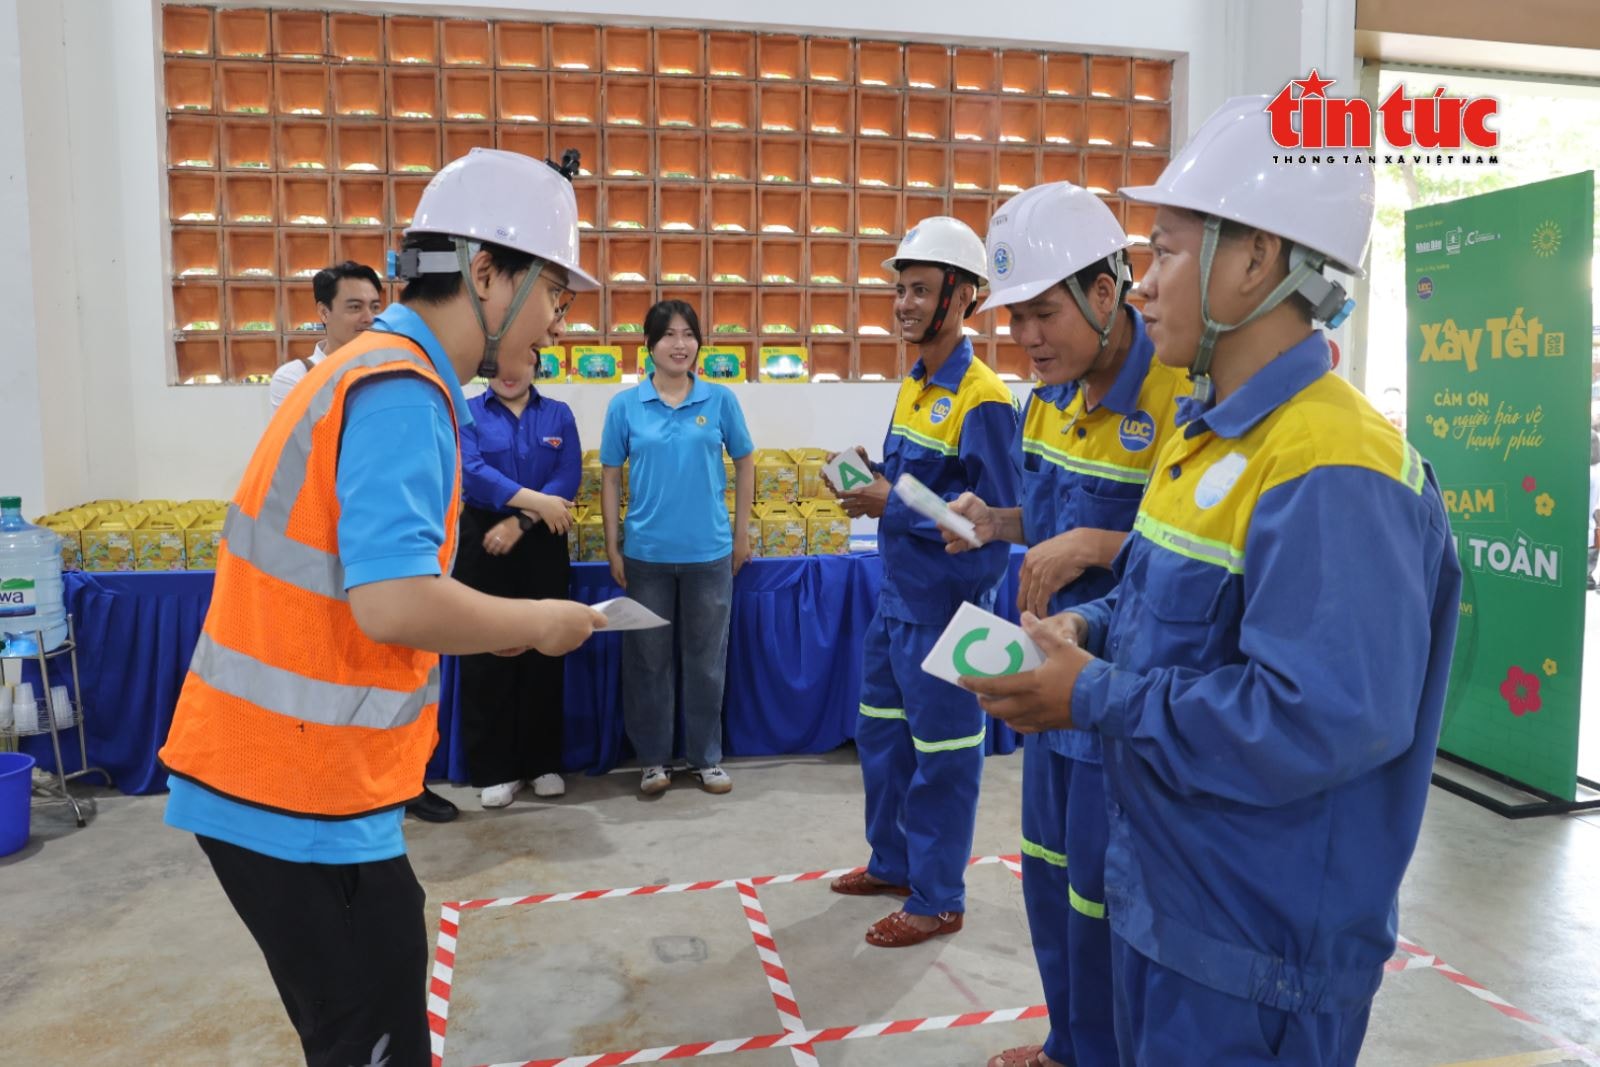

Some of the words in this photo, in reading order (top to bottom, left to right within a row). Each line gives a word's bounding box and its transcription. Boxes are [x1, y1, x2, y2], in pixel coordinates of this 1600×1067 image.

[1419, 318, 1483, 373] Xây
[1486, 307, 1543, 359] Tết
[933, 402, 950, 416] UDC
[1434, 388, 1462, 406] CẢM
[1467, 390, 1489, 406] ƠN
[1123, 419, 1152, 437] UDC
[1452, 408, 1490, 440] người
[1495, 401, 1522, 425] bảo
[1504, 427, 1545, 462] phúc
[838, 460, 873, 491] A
[1443, 488, 1496, 520] RẠM
[1468, 536, 1558, 581] TOÀN
[0, 591, 24, 603] wa
[952, 627, 1024, 677] C
